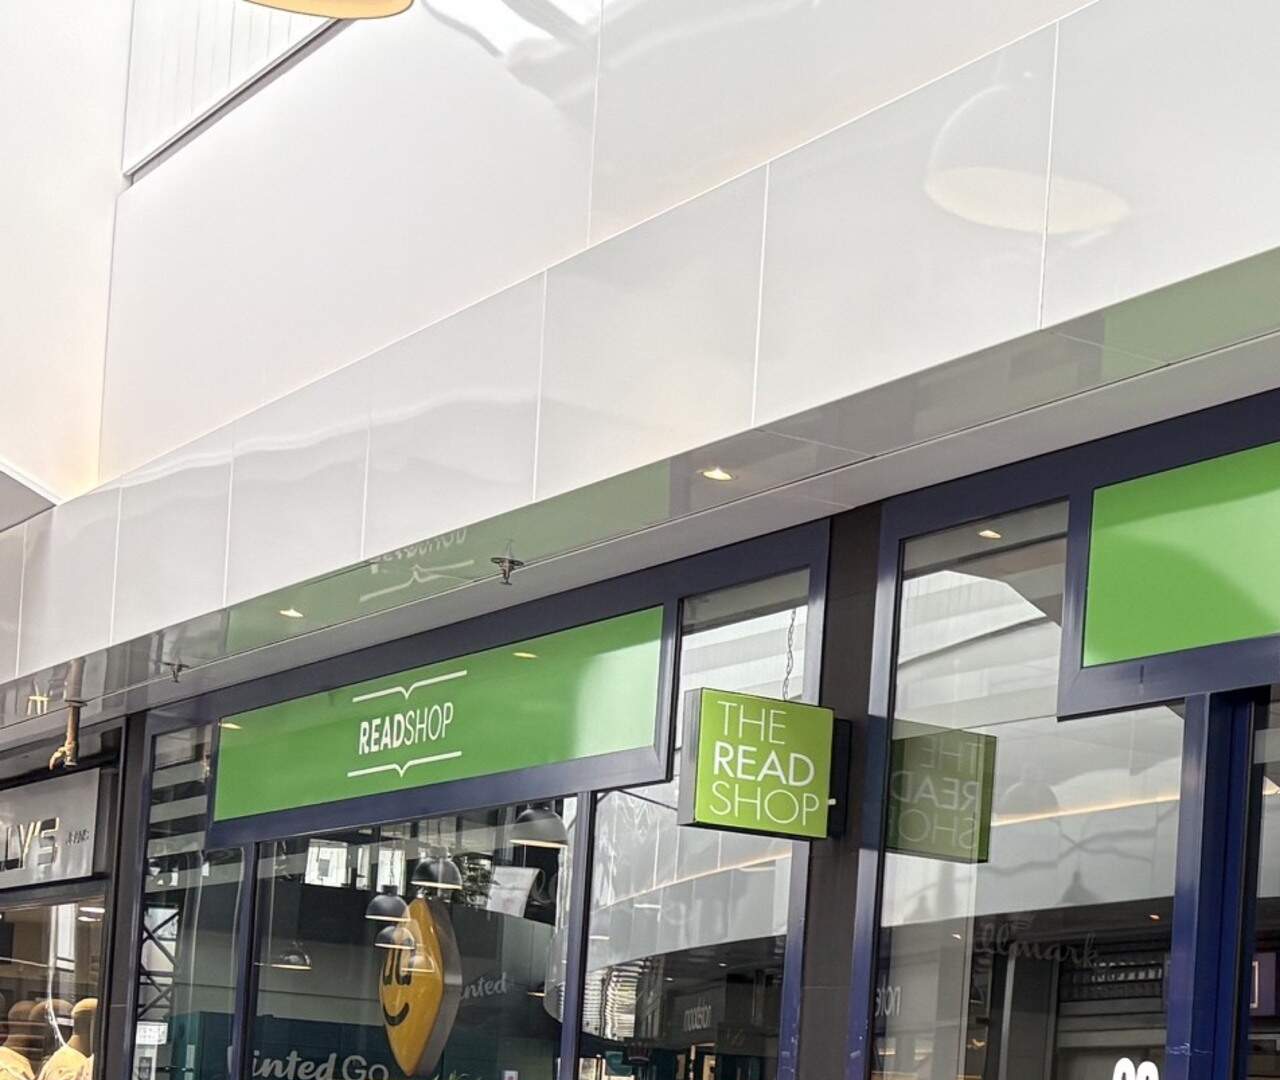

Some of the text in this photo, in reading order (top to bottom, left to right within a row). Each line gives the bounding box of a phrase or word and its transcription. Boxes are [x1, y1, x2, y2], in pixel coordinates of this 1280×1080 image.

[358, 702, 454, 754] READSHOP
[717, 701, 786, 744] THE
[714, 741, 814, 786] READ
[709, 781, 819, 826] SHOP
